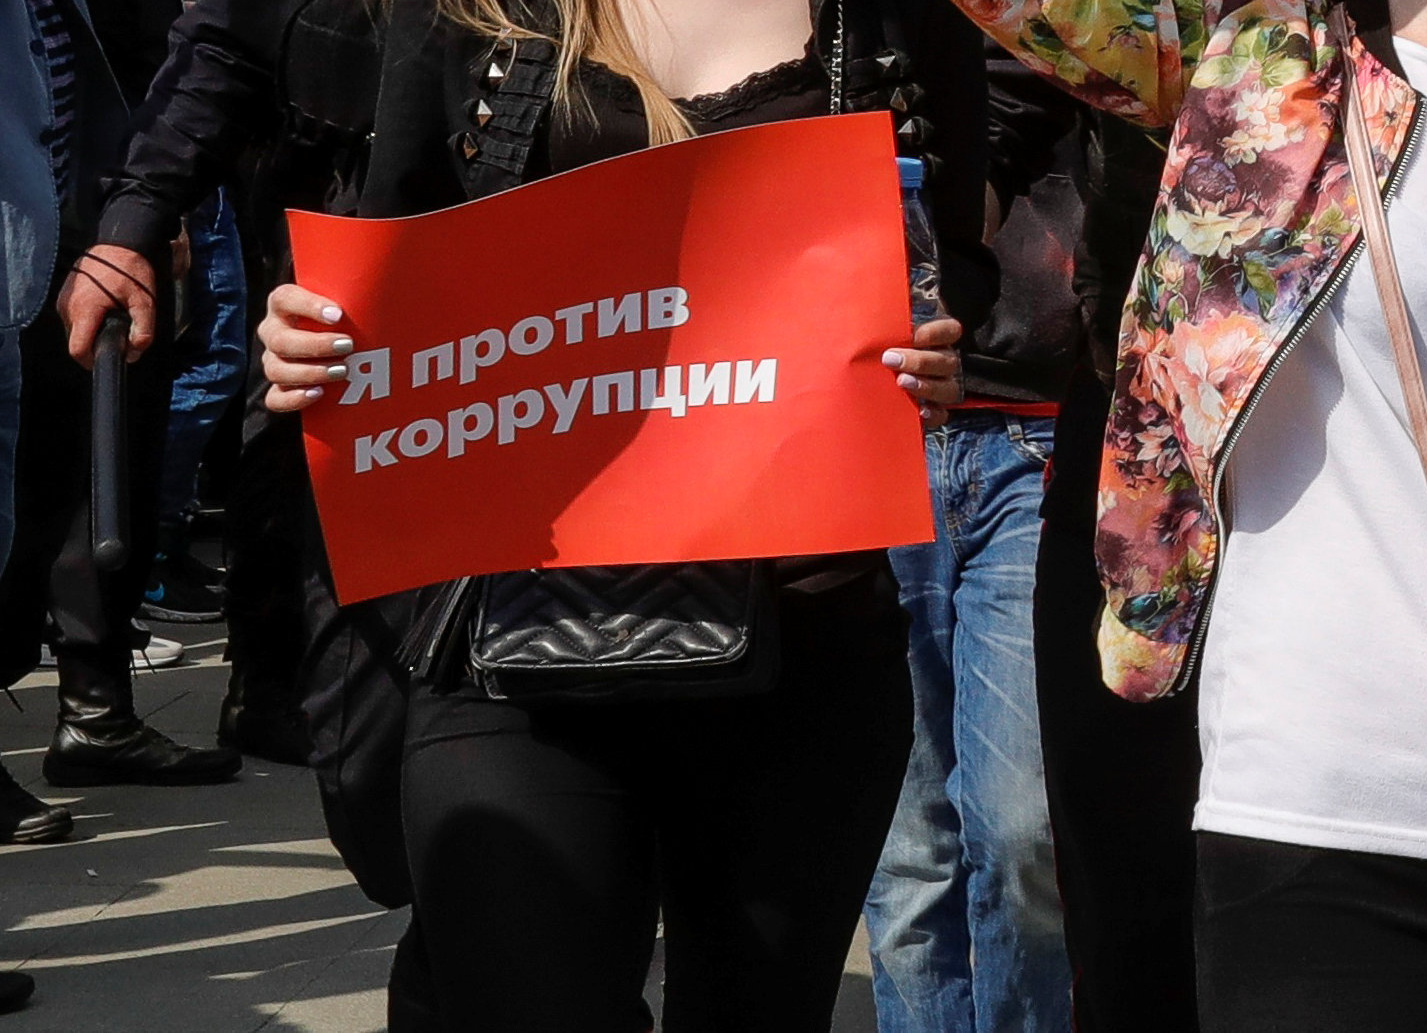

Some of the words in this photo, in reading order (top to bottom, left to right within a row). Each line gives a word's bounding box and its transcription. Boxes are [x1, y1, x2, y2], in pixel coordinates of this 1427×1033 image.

[338, 347, 391, 405] Я
[412, 286, 690, 387] против
[354, 358, 778, 474] коррупции
